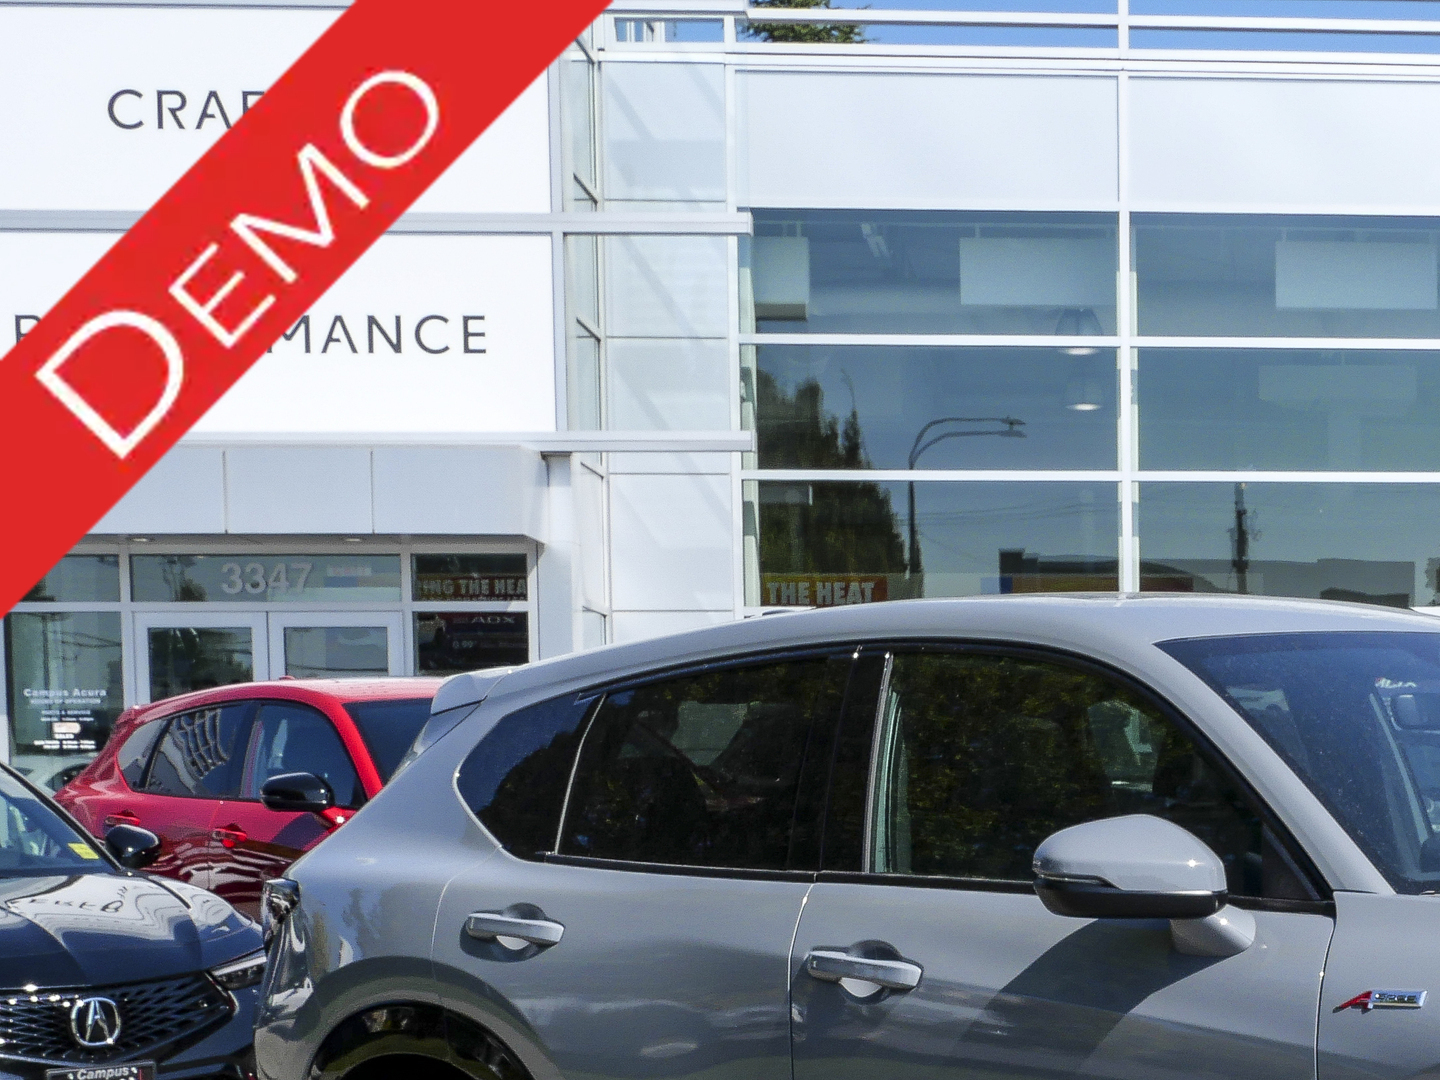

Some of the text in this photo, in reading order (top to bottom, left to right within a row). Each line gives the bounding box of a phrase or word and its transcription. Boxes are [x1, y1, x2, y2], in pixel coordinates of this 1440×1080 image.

[107, 88, 266, 130] CRAF
[220, 562, 313, 595] 3347
[460, 579, 490, 595] THE
[493, 579, 527, 595] HEA
[767, 581, 875, 605] THE HEAT
[73, 688, 107, 698] Acura
[77, 1067, 129, 1080] Campus
